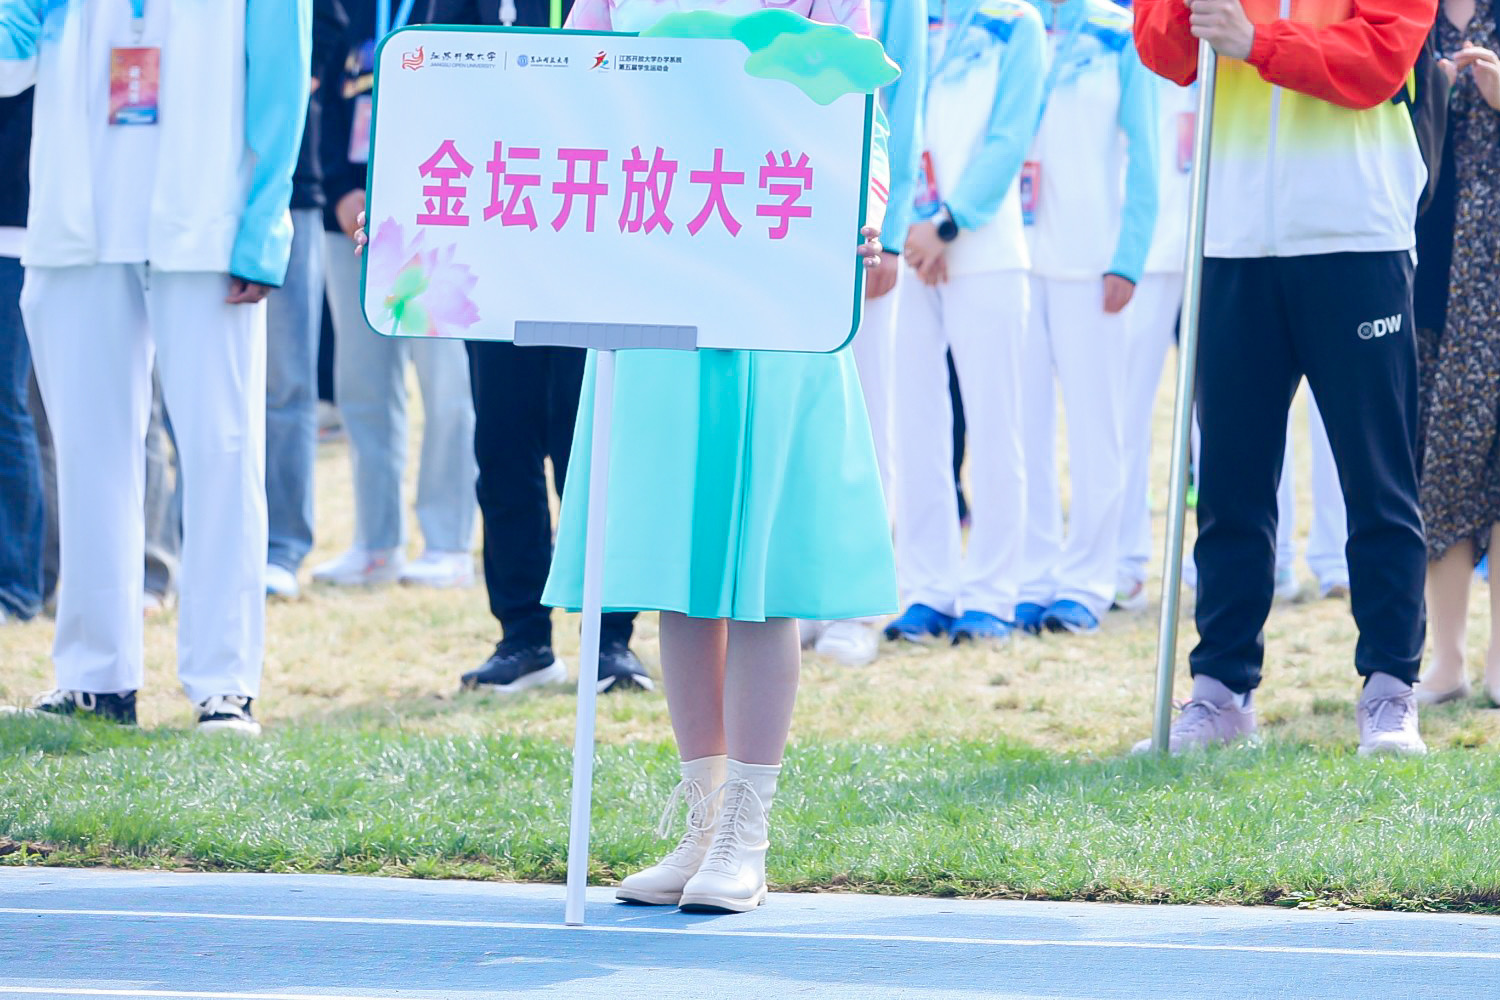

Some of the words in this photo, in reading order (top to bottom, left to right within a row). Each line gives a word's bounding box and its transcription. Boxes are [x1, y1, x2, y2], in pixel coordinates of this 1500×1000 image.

[416, 138, 815, 241] 金坛开放大学
